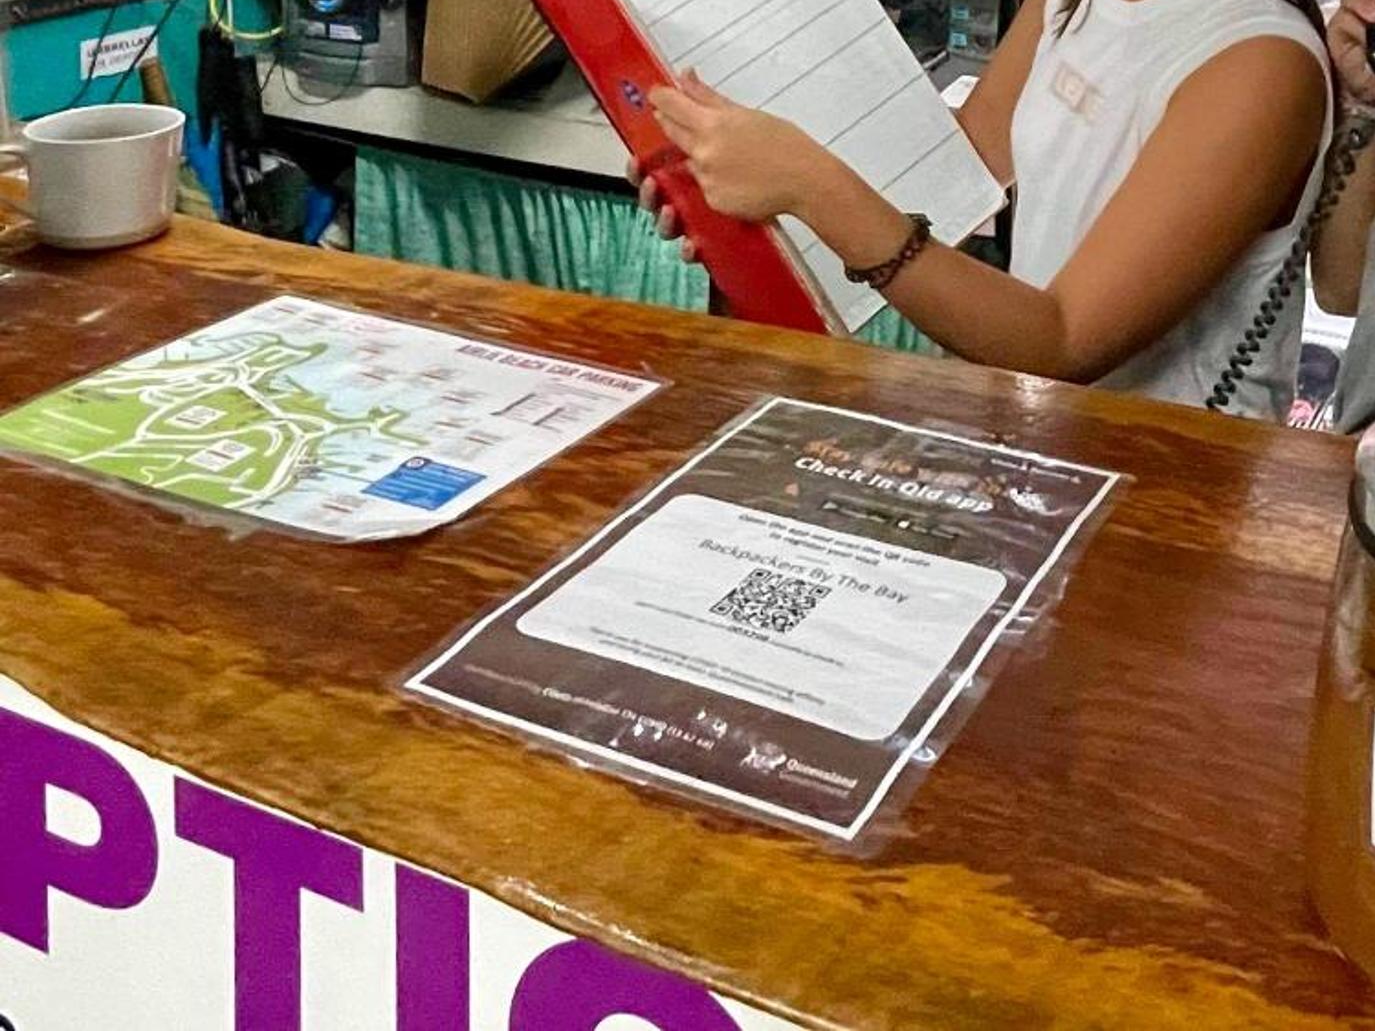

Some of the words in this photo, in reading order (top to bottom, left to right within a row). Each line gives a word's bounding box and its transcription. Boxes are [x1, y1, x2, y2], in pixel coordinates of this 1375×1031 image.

[794, 455, 864, 484] Check
[898, 480, 945, 500] Qld
[944, 492, 995, 514] app
[698, 538, 808, 574] Backpackers
[809, 567, 834, 583] By
[837, 574, 871, 593] The
[874, 584, 910, 605] Bay
